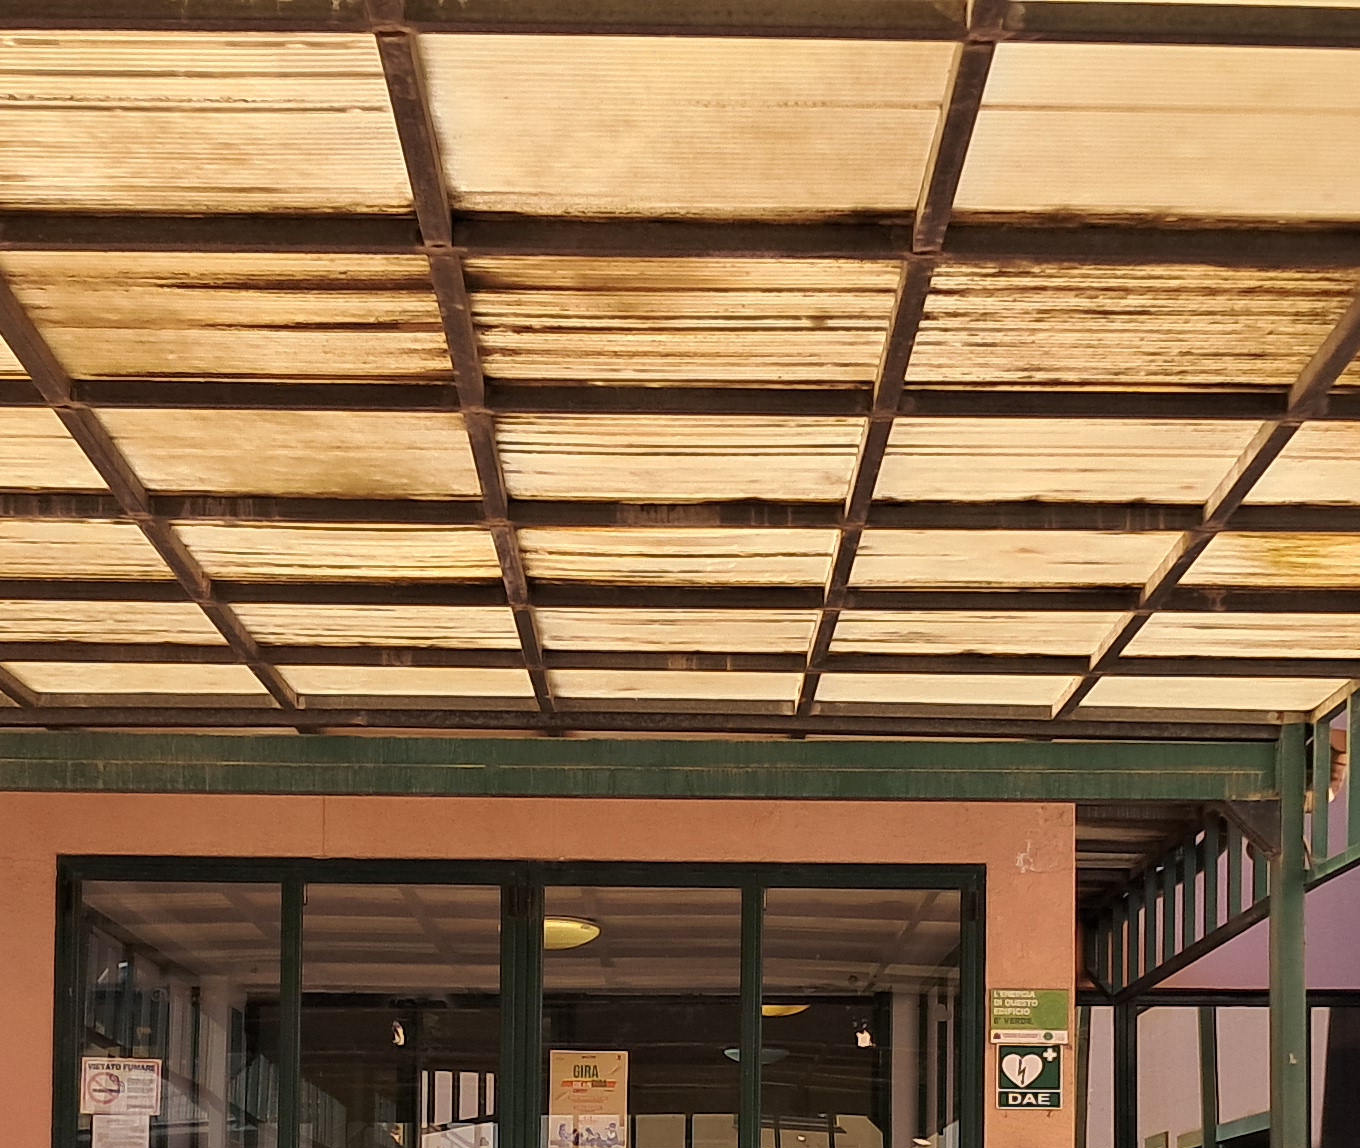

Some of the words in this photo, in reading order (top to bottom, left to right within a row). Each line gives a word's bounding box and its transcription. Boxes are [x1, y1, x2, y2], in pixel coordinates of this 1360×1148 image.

[993, 990, 1036, 998] L'ENERGIA
[993, 999, 1003, 1007] DI
[1004, 999, 1039, 1007] QUESTO
[993, 1007, 1031, 1015] EDIFICIO
[87, 1063, 122, 1071] VIETATO
[122, 1063, 156, 1073] FUMARE
[573, 1064, 599, 1079] GIRA
[1007, 1093, 1052, 1106] DAE
